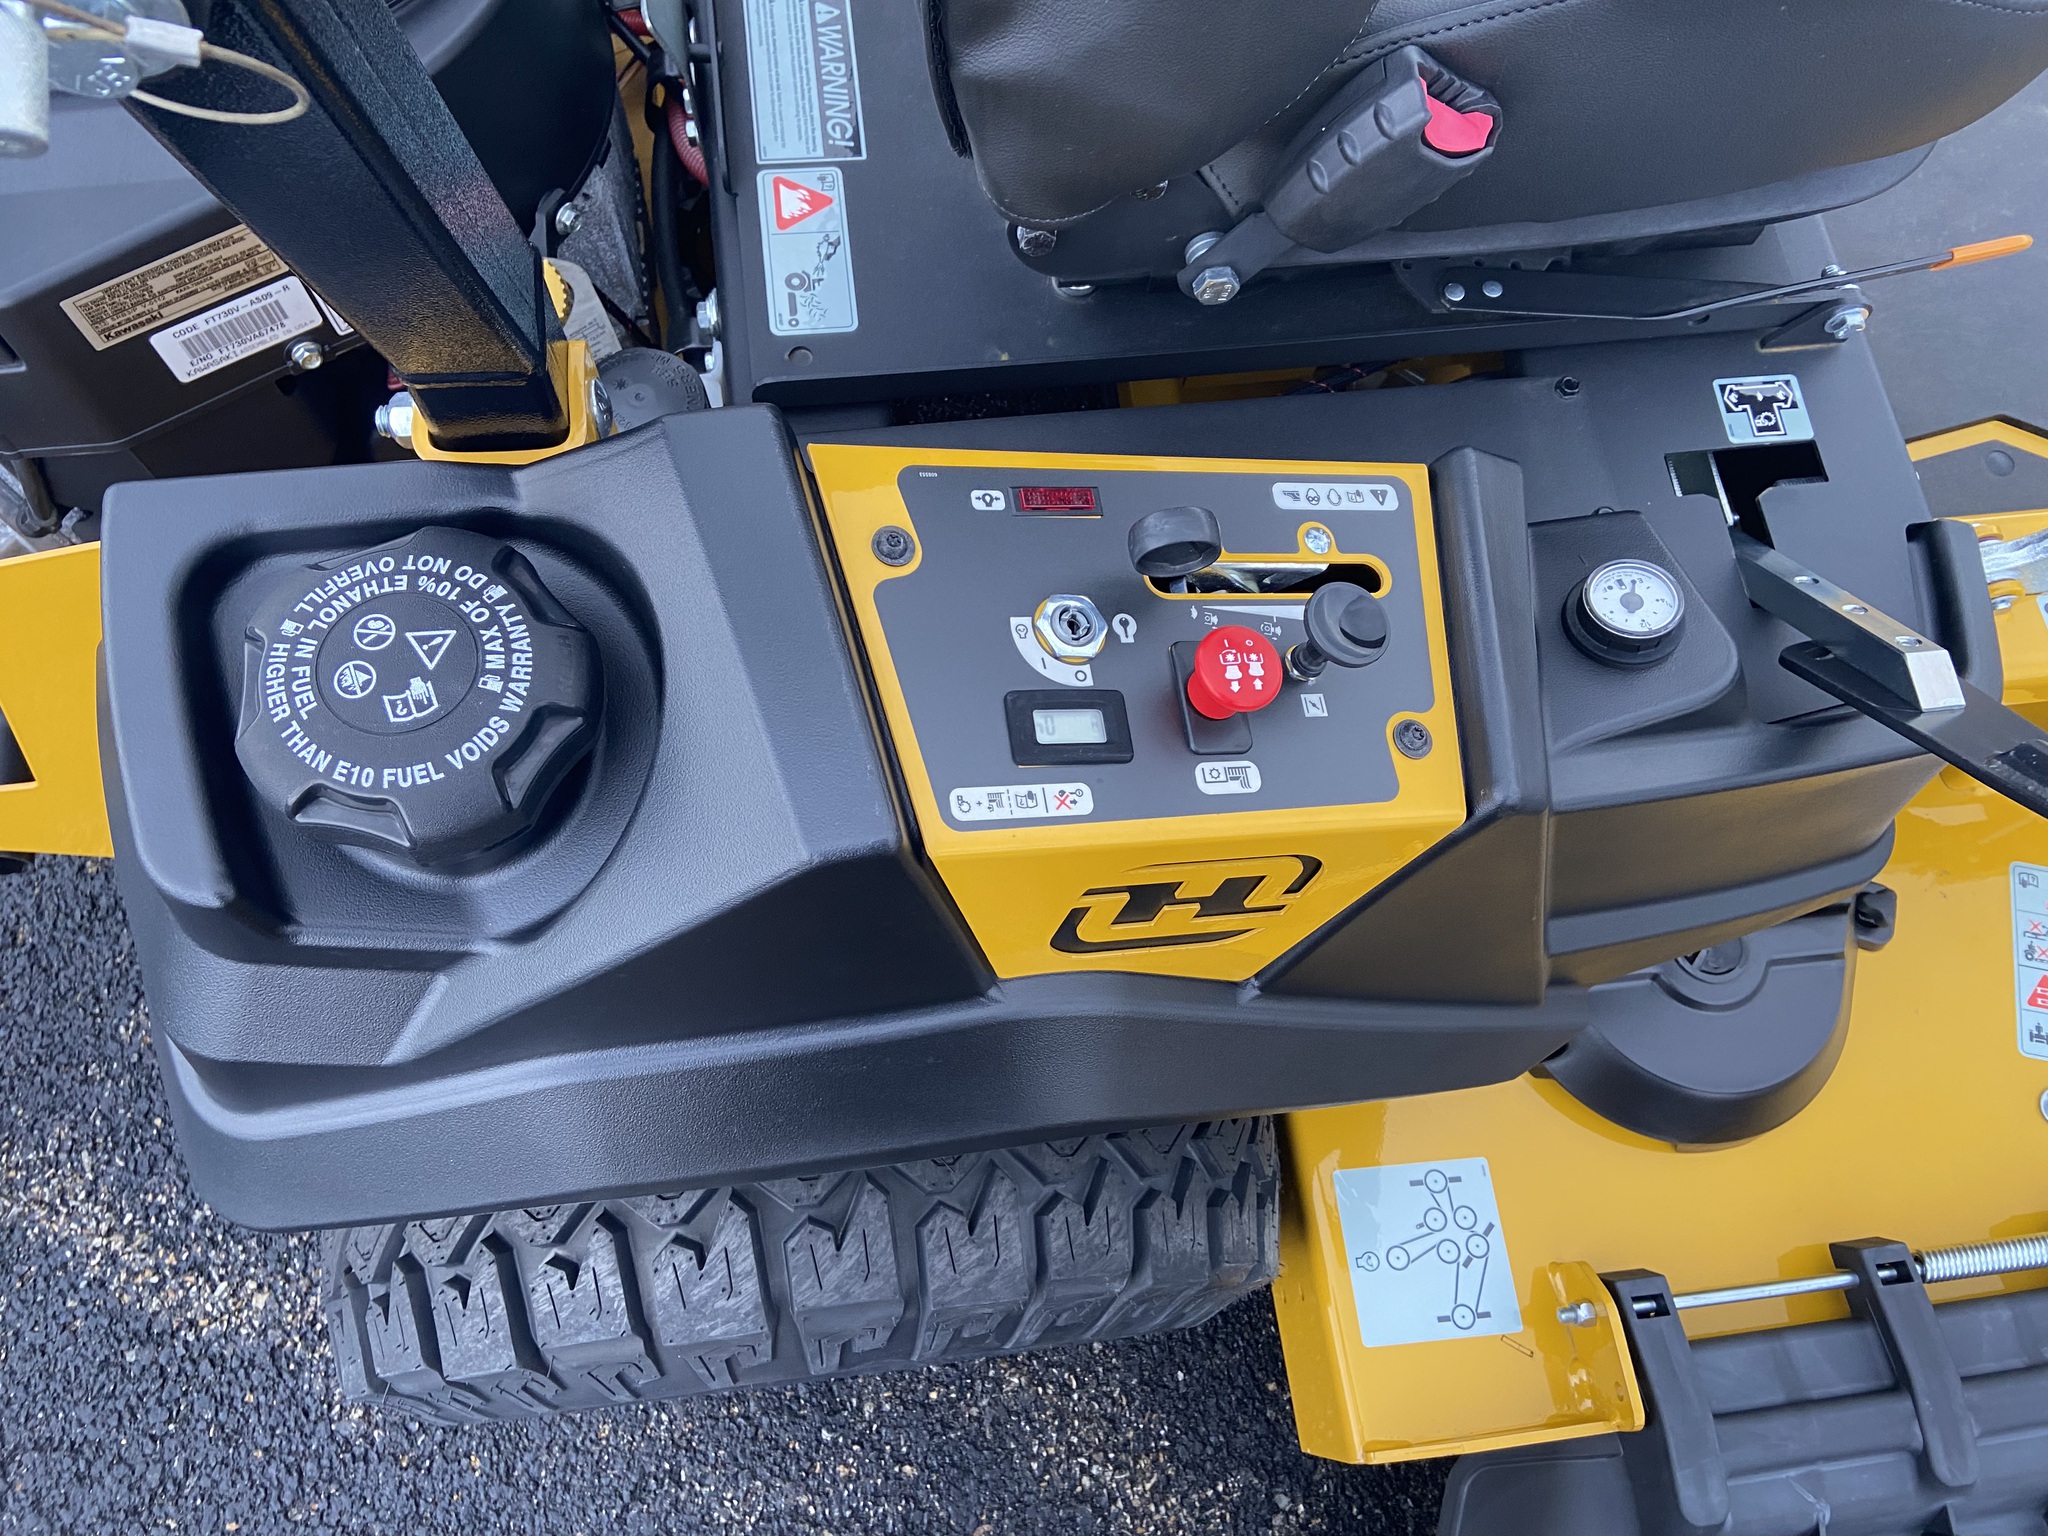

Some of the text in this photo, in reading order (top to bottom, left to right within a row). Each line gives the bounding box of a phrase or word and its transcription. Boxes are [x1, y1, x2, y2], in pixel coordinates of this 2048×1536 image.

[817, 25, 854, 146] WARNING!
[102, 310, 164, 341] Kawasaki
[172, 323, 200, 339] CODE
[186, 351, 239, 378] KAWASAKI
[294, 554, 488, 615] DO NOT OVERFILL
[291, 575, 506, 720] MAX OF 10% ETHANOL IN FUEL
[265, 642, 291, 723] HIGHER
[281, 721, 331, 773] THAN
[332, 760, 375, 787] E10
[382, 761, 445, 788] FUEL
[445, 715, 510, 771] VOIDS
[497, 604, 533, 714] WARRANTY
